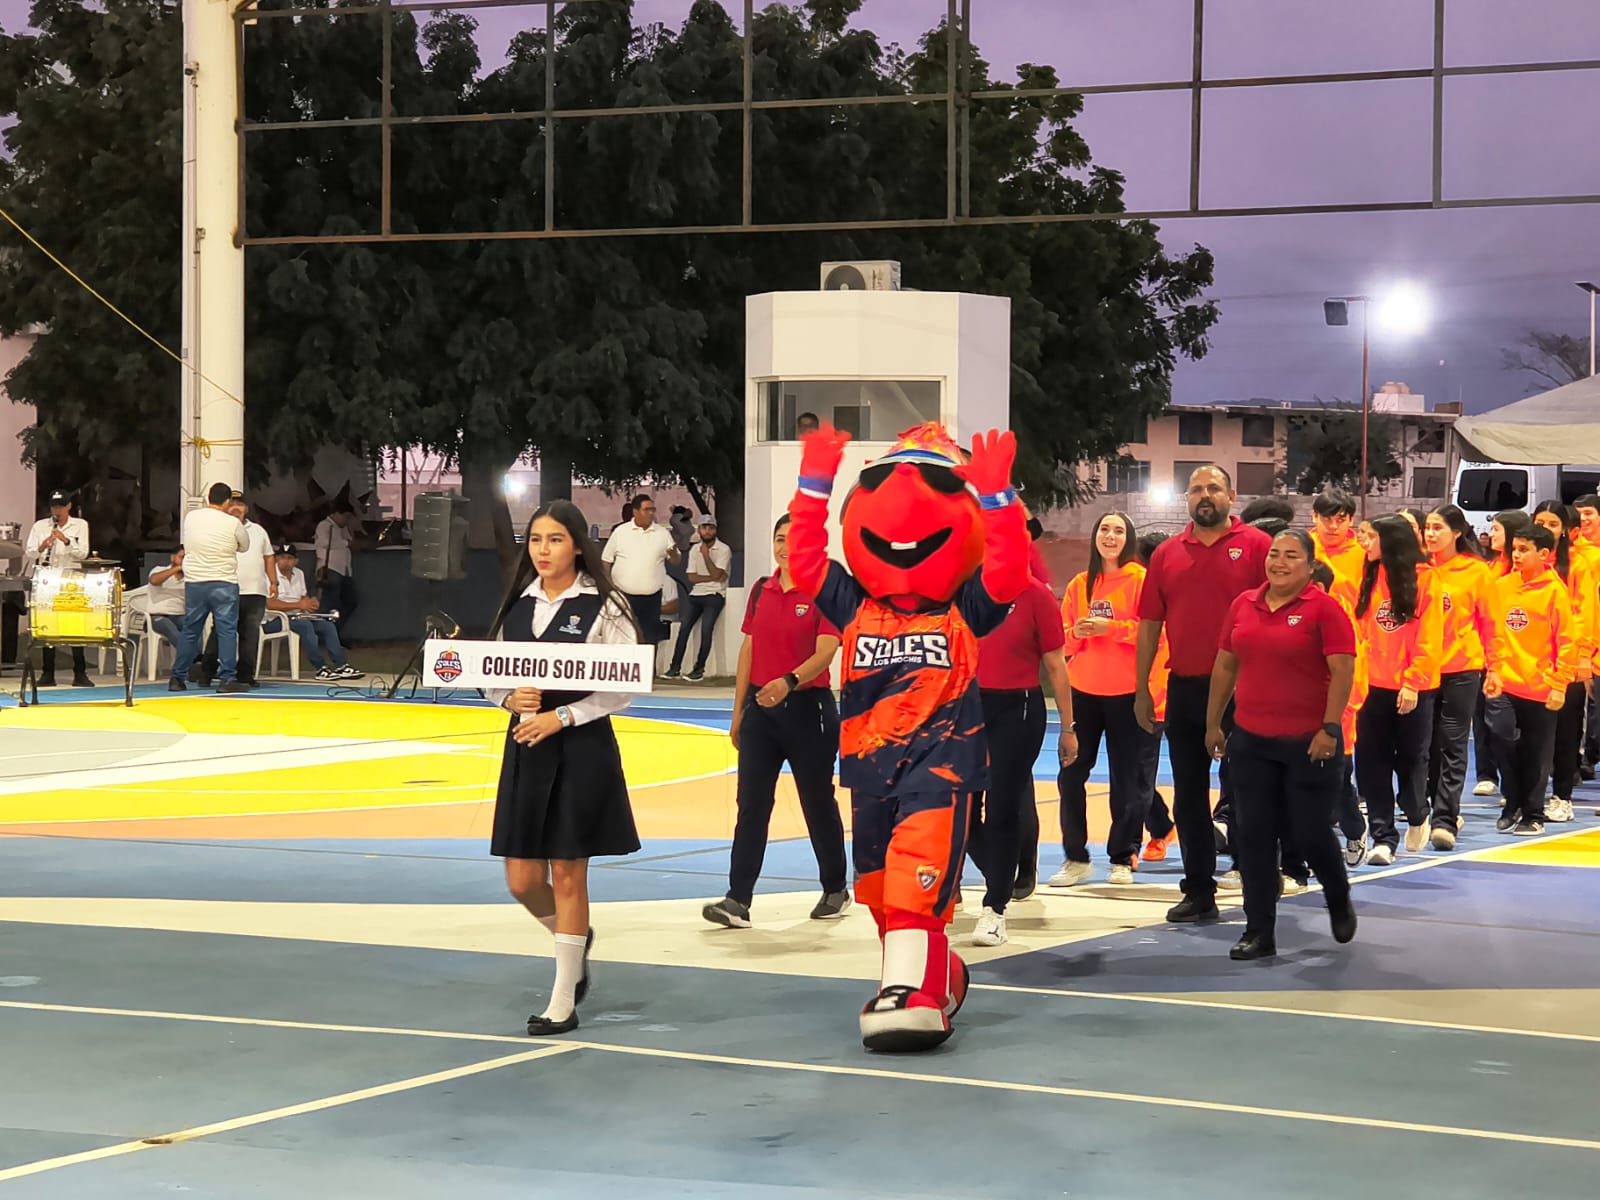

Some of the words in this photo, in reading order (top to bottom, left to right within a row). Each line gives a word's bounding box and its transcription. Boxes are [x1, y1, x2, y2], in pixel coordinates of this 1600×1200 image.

[854, 634, 951, 667] SOLES
[874, 658, 889, 666] LOS
[890, 656, 922, 664] MOCHIS
[482, 656, 548, 677] COLEGIO
[552, 659, 586, 680] SOR
[589, 661, 641, 682] JUANA
